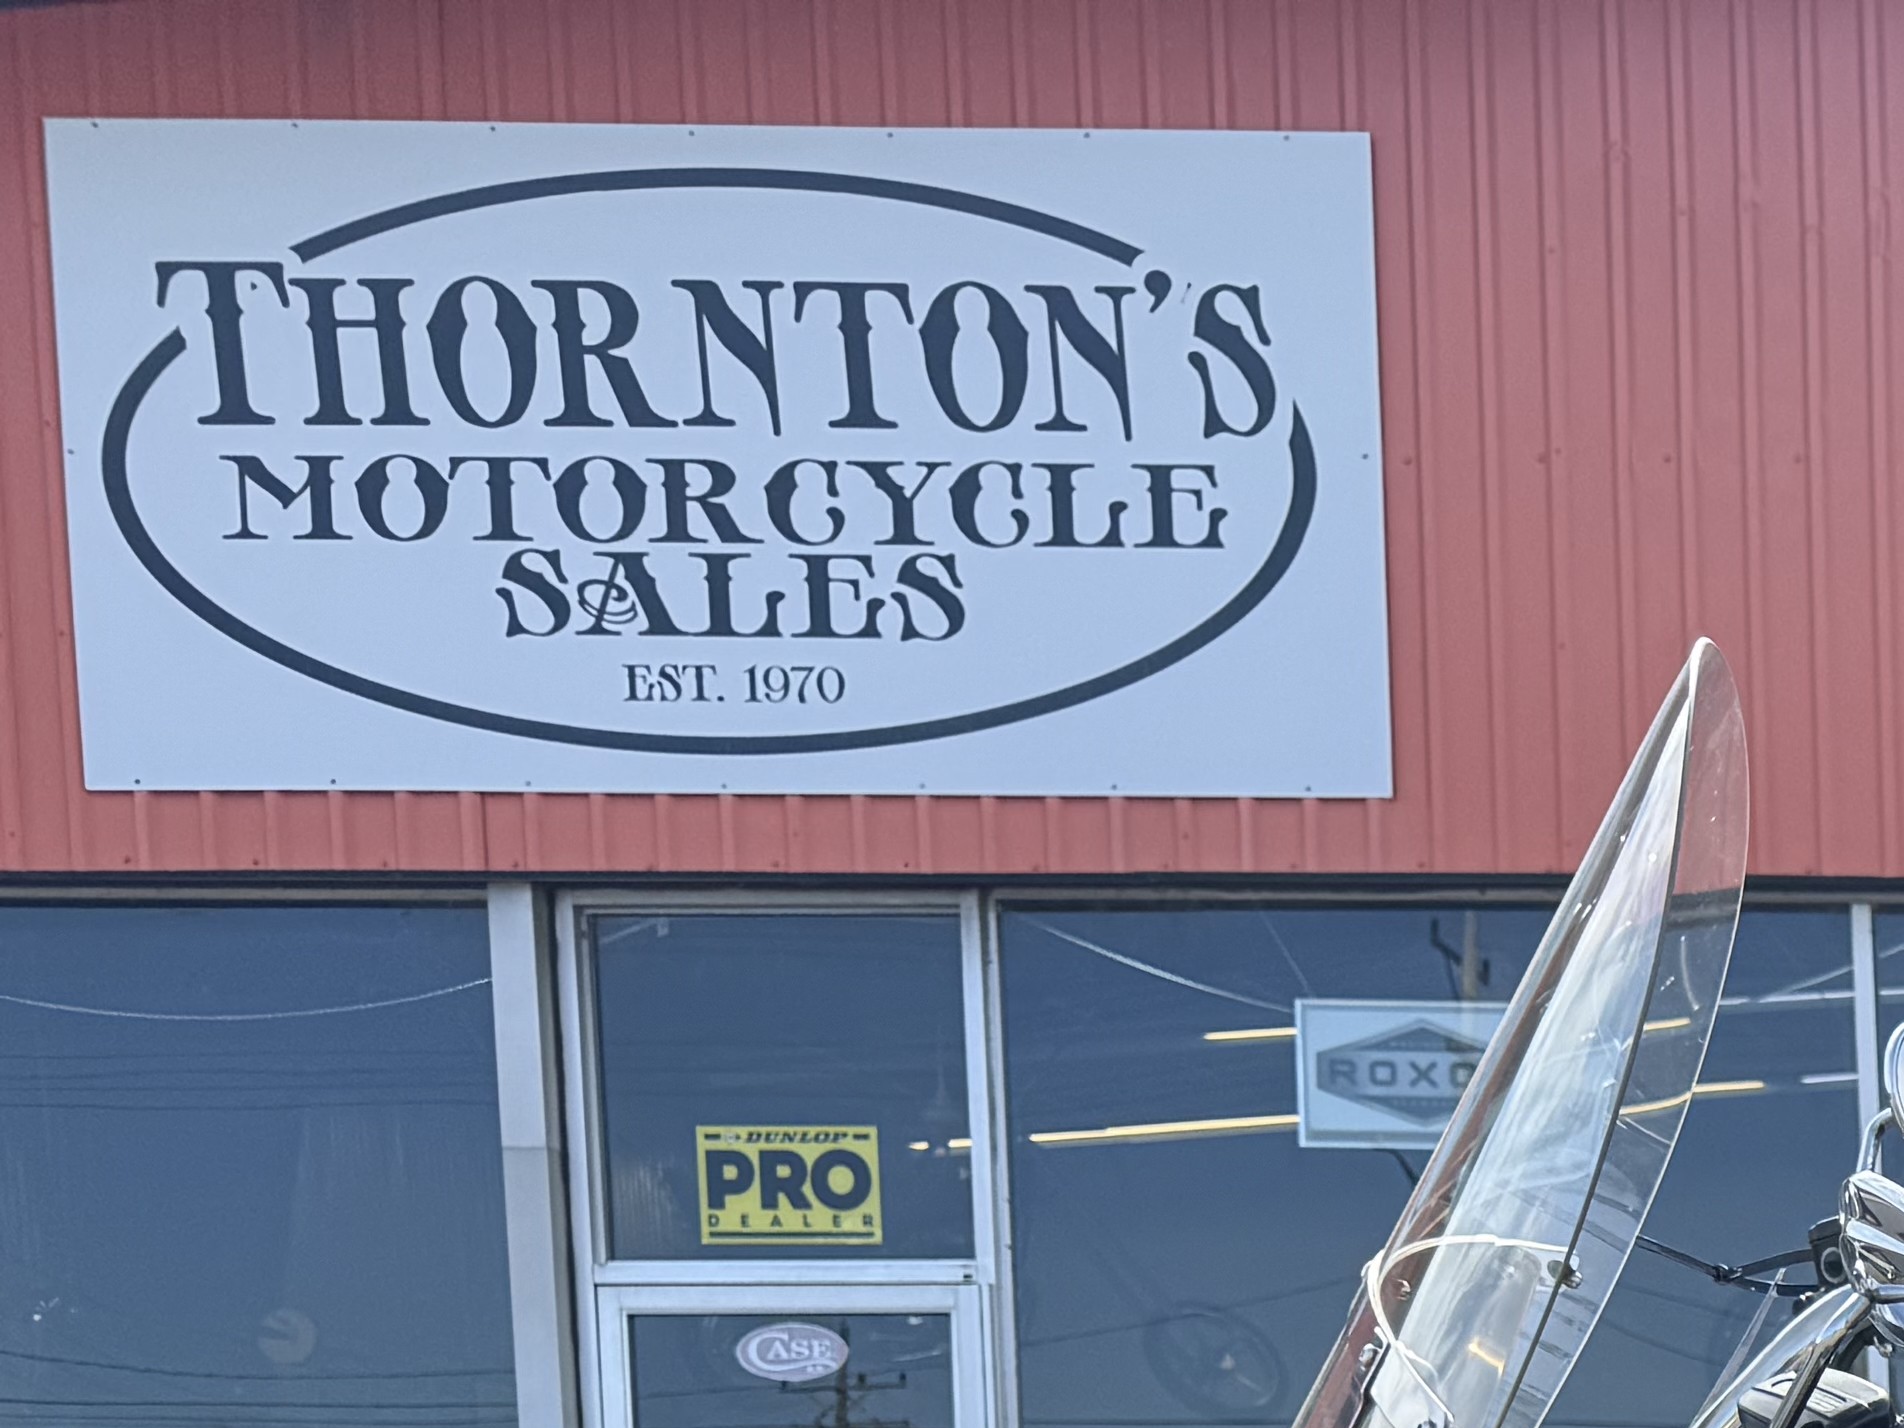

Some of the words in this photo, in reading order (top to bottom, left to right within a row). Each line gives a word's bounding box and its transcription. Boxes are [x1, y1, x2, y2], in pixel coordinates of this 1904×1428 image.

[154, 258, 1280, 440] THORNTON'S
[222, 453, 1228, 549] MOTORCYCLE
[498, 547, 967, 642] SALES
[622, 662, 726, 705] EST.
[743, 663, 847, 706] 1970
[1328, 1058, 1476, 1088] ROXO
[744, 1130, 849, 1144] DUNLOP
[704, 1148, 873, 1211] PRO
[707, 1213, 874, 1229] DEALER
